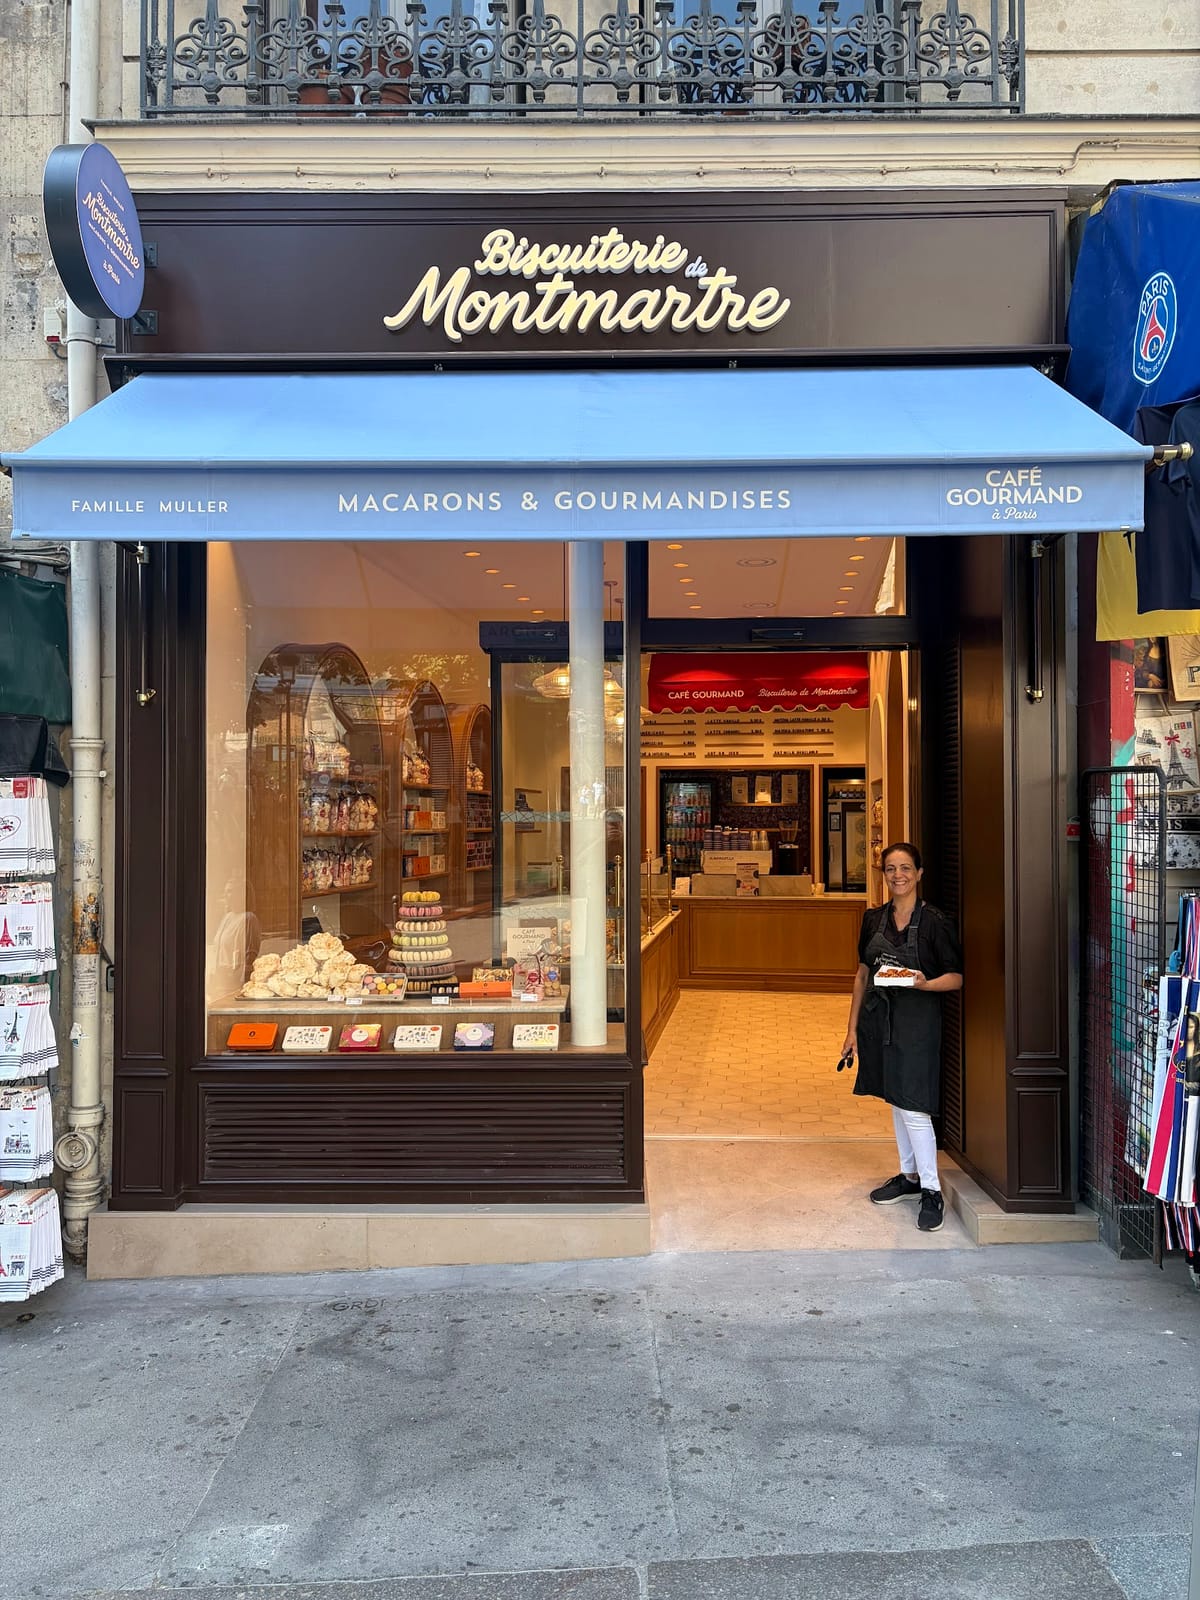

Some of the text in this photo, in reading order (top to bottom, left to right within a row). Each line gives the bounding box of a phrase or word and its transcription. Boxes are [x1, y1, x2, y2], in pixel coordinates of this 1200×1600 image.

[82, 191, 140, 269] Montmartre
[475, 227, 709, 279] Biscuiterie de
[383, 266, 791, 343] Montmartre
[1141, 278, 1169, 316] PARIS
[985, 466, 1042, 487] CAFÉ
[71, 500, 228, 513] FAMILLE MULLER
[338, 490, 791, 513] MACARONS & GOURMANDISES
[946, 486, 1083, 506] GOURMAND
[992, 506, 1037, 520] à Paris
[668, 686, 858, 700] CAFÉ GOURMAND Biscuiterie de Montmartre
